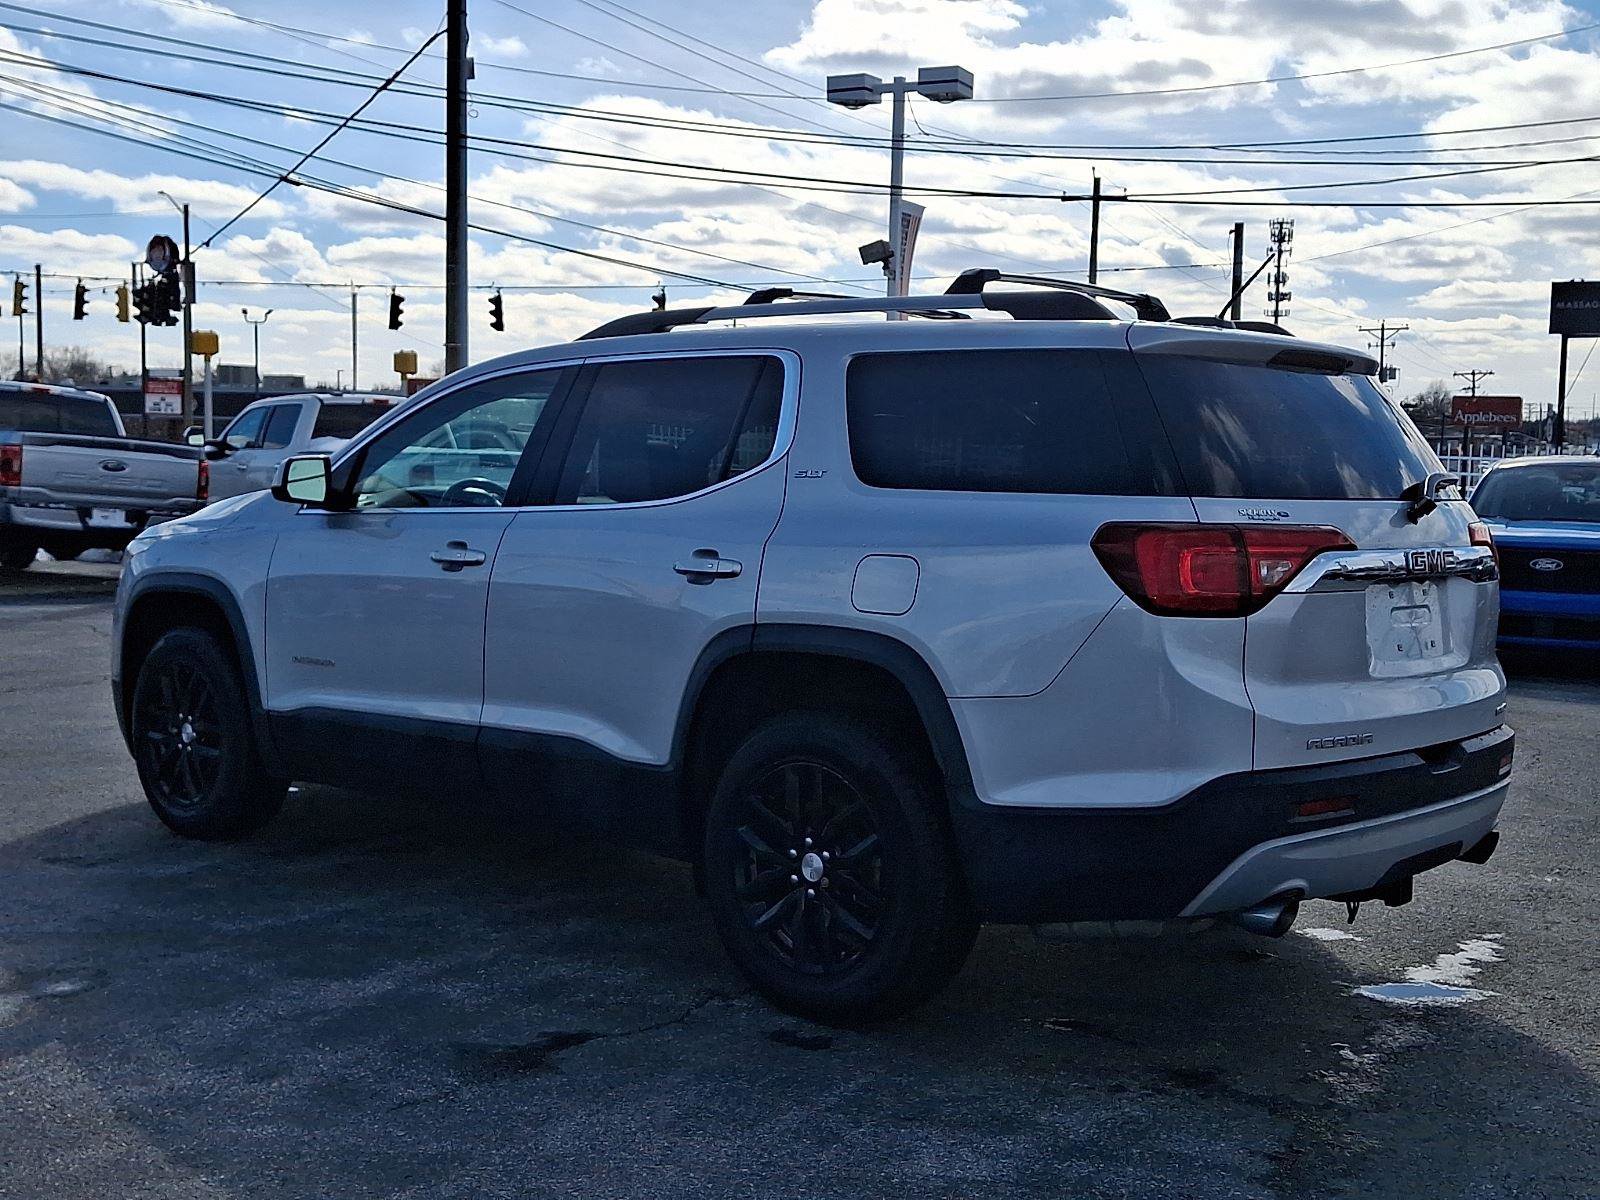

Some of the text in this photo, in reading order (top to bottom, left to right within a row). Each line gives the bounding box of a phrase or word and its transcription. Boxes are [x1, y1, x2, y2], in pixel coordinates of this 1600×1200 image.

[794, 469, 828, 479] SLT
[1405, 549, 1457, 572] GMC
[1306, 733, 1374, 750] ACADIA
